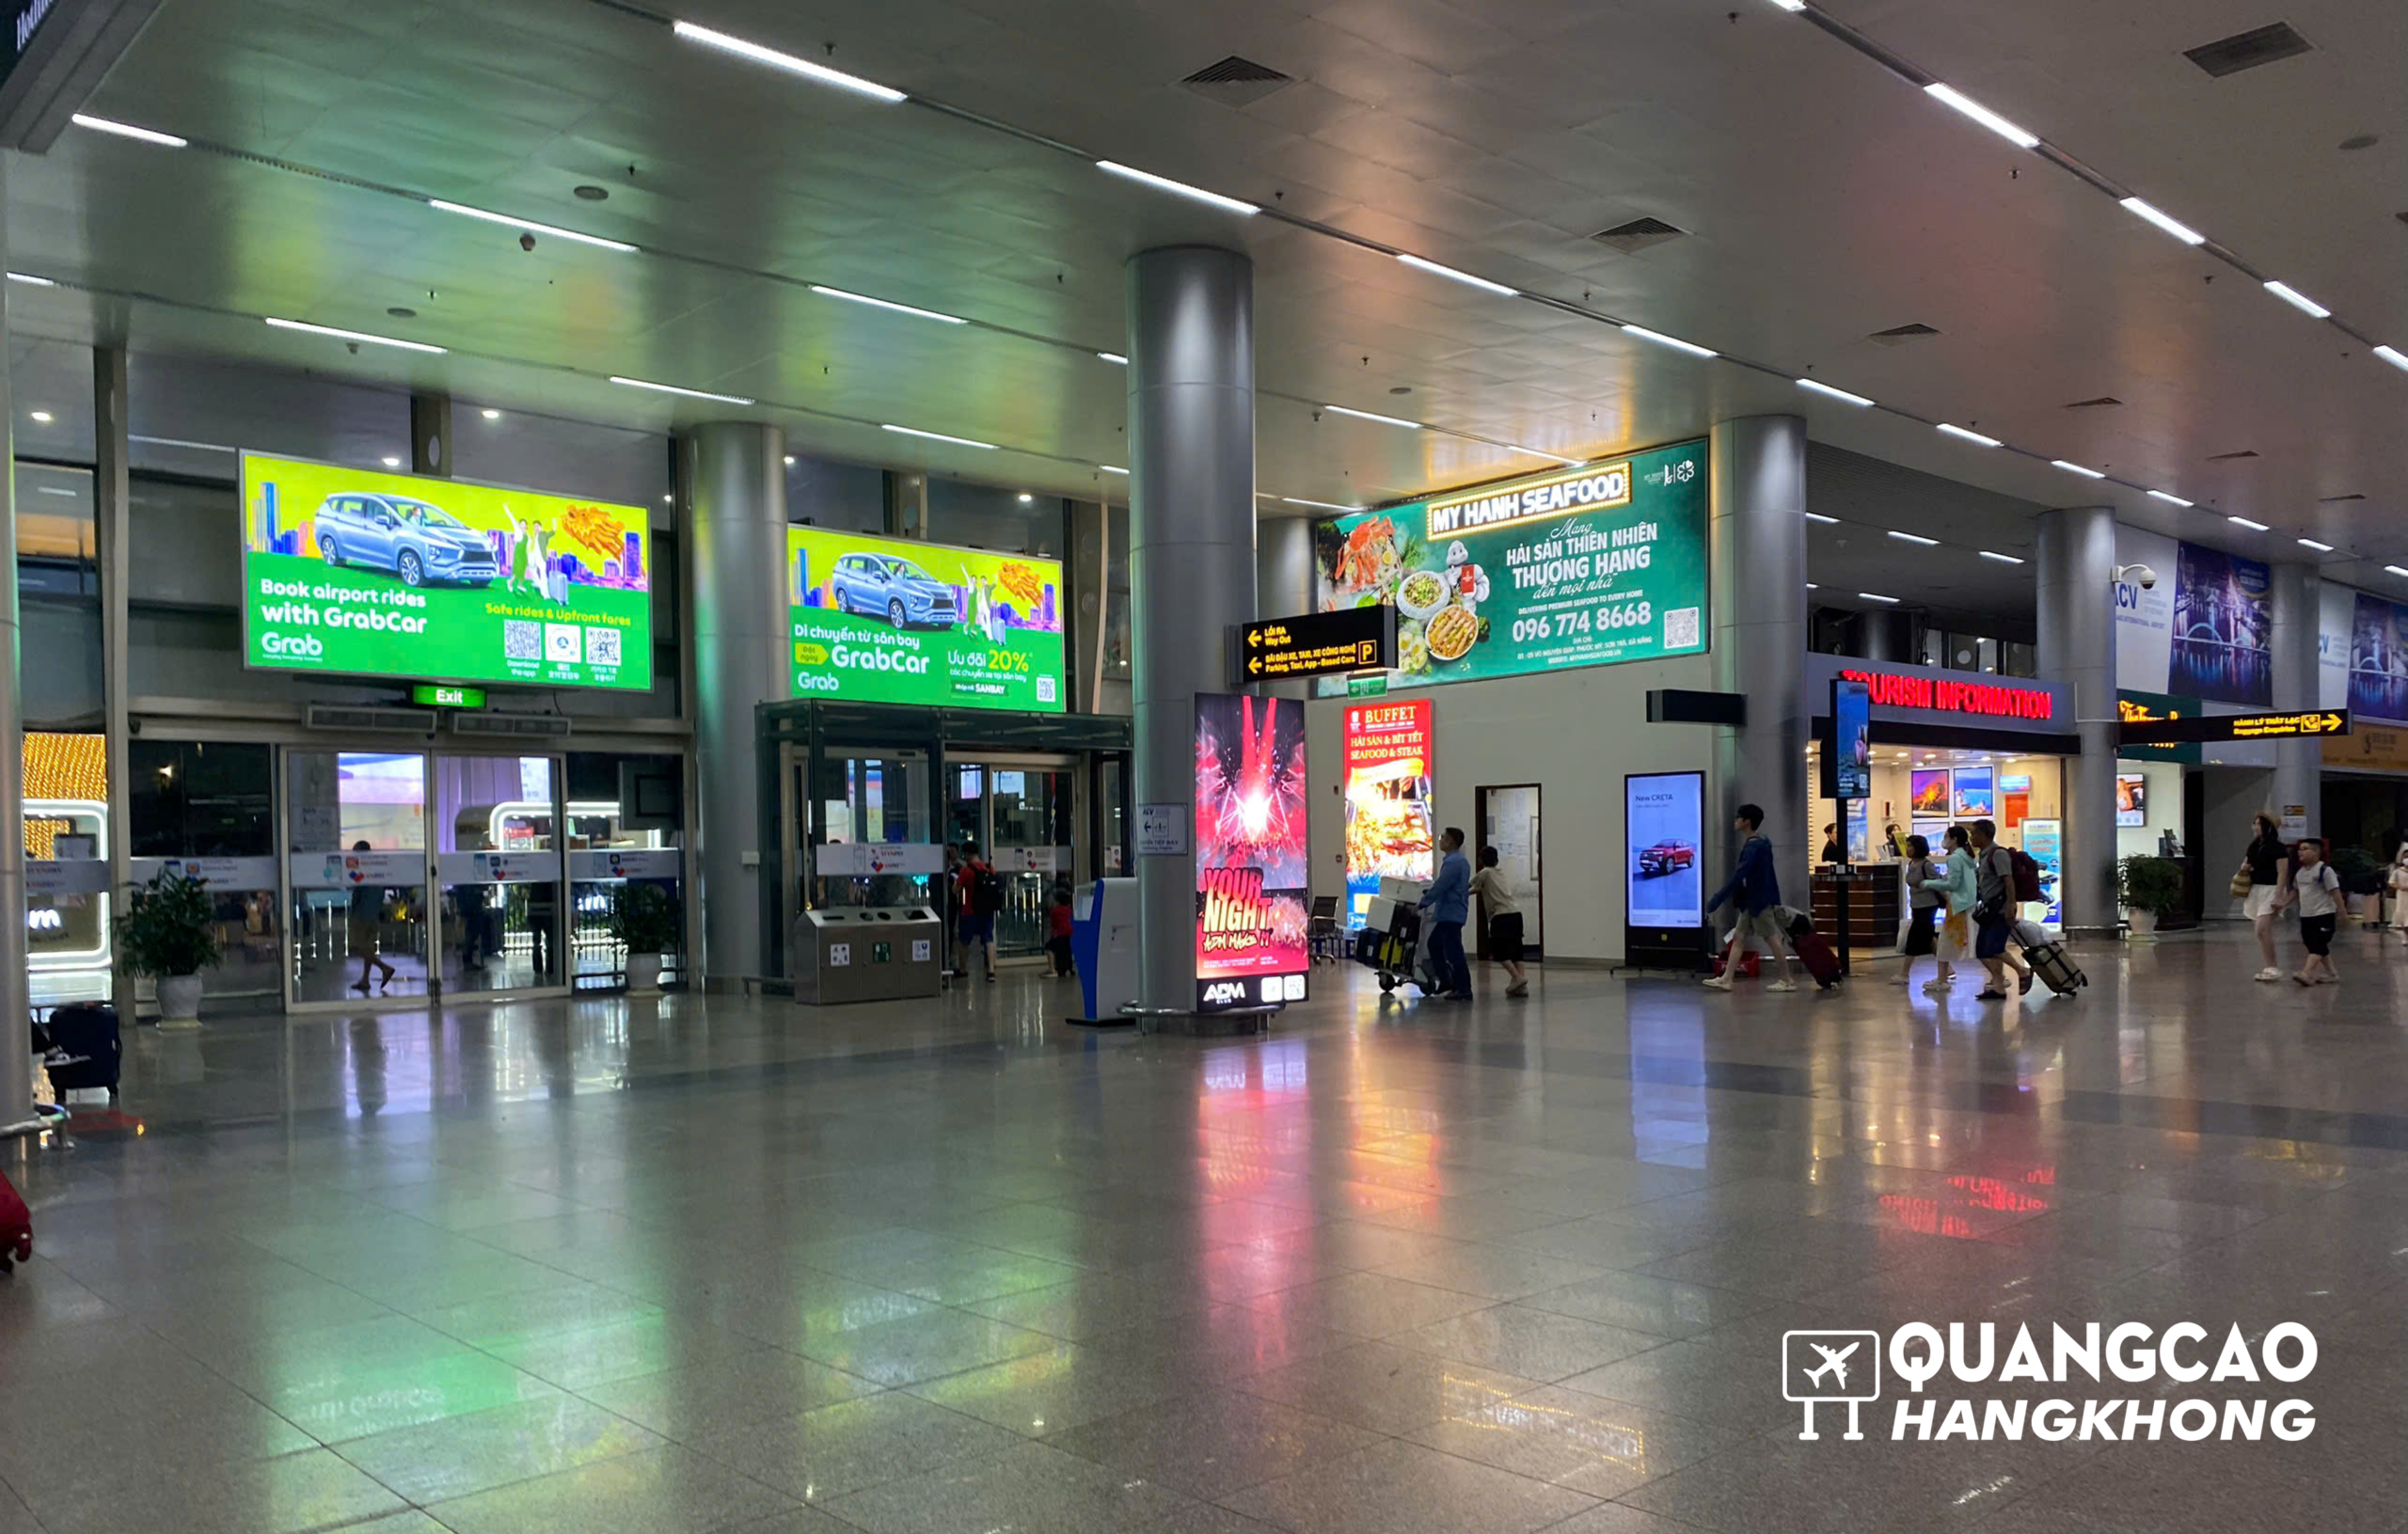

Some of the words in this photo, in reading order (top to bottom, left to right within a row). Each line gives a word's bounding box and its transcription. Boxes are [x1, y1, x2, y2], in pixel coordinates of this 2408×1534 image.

[1433, 505, 1461, 533] MY
[1464, 493, 1519, 527] HANH
[1522, 472, 1624, 515] SEAFOOD
[1550, 517, 1592, 539] Mang
[1506, 543, 1530, 566] HẢI
[1533, 538, 1562, 561] SẢN
[1565, 530, 1608, 555] THIÊN
[1611, 521, 1657, 547] NHIÊN
[1513, 557, 1590, 590] THƯỢNG
[1595, 546, 1651, 577] HẠNG
[261, 578, 310, 598] Book
[313, 583, 378, 605] airport
[381, 589, 426, 608] rides
[1532, 581, 1557, 600] đến
[1559, 578, 1584, 597] mọi
[1586, 571, 1613, 592] nhà
[485, 603, 513, 616] Safe
[515, 606, 545, 619] rides
[556, 609, 600, 624] Upfront
[602, 612, 631, 626] fares
[1518, 604, 1547, 615] DELIVERING
[1547, 601, 1573, 611] PREMIUM
[1574, 596, 1599, 608] SEAFOOD
[1608, 592, 1625, 601] EVERY
[1625, 589, 1643, 599] HOME
[261, 601, 320, 625] with
[324, 607, 428, 634] GrabCar
[1513, 616, 1551, 642] 096
[1555, 610, 1591, 637] 774
[1595, 601, 1652, 631] 8668
[261, 631, 324, 656] Grab
[873, 631, 895, 645] sân
[896, 632, 920, 651] bay
[1279, 635, 1291, 644] Out
[832, 644, 930, 674] GrabCar
[1362, 644, 1373, 661] P
[798, 672, 839, 691] Grab
[974, 683, 1006, 694] SANBAY
[436, 689, 464, 704] Exit
[1935, 679, 2052, 720] INFORMATION
[1365, 706, 1417, 723] BUFFET
[1350, 749, 1388, 760] SEAFOOD
[1397, 746, 1424, 756] STEAK
[1205, 868, 1262, 900] YOUR
[1203, 897, 1273, 932] NIGHT
[1203, 982, 1246, 1002] ADM
